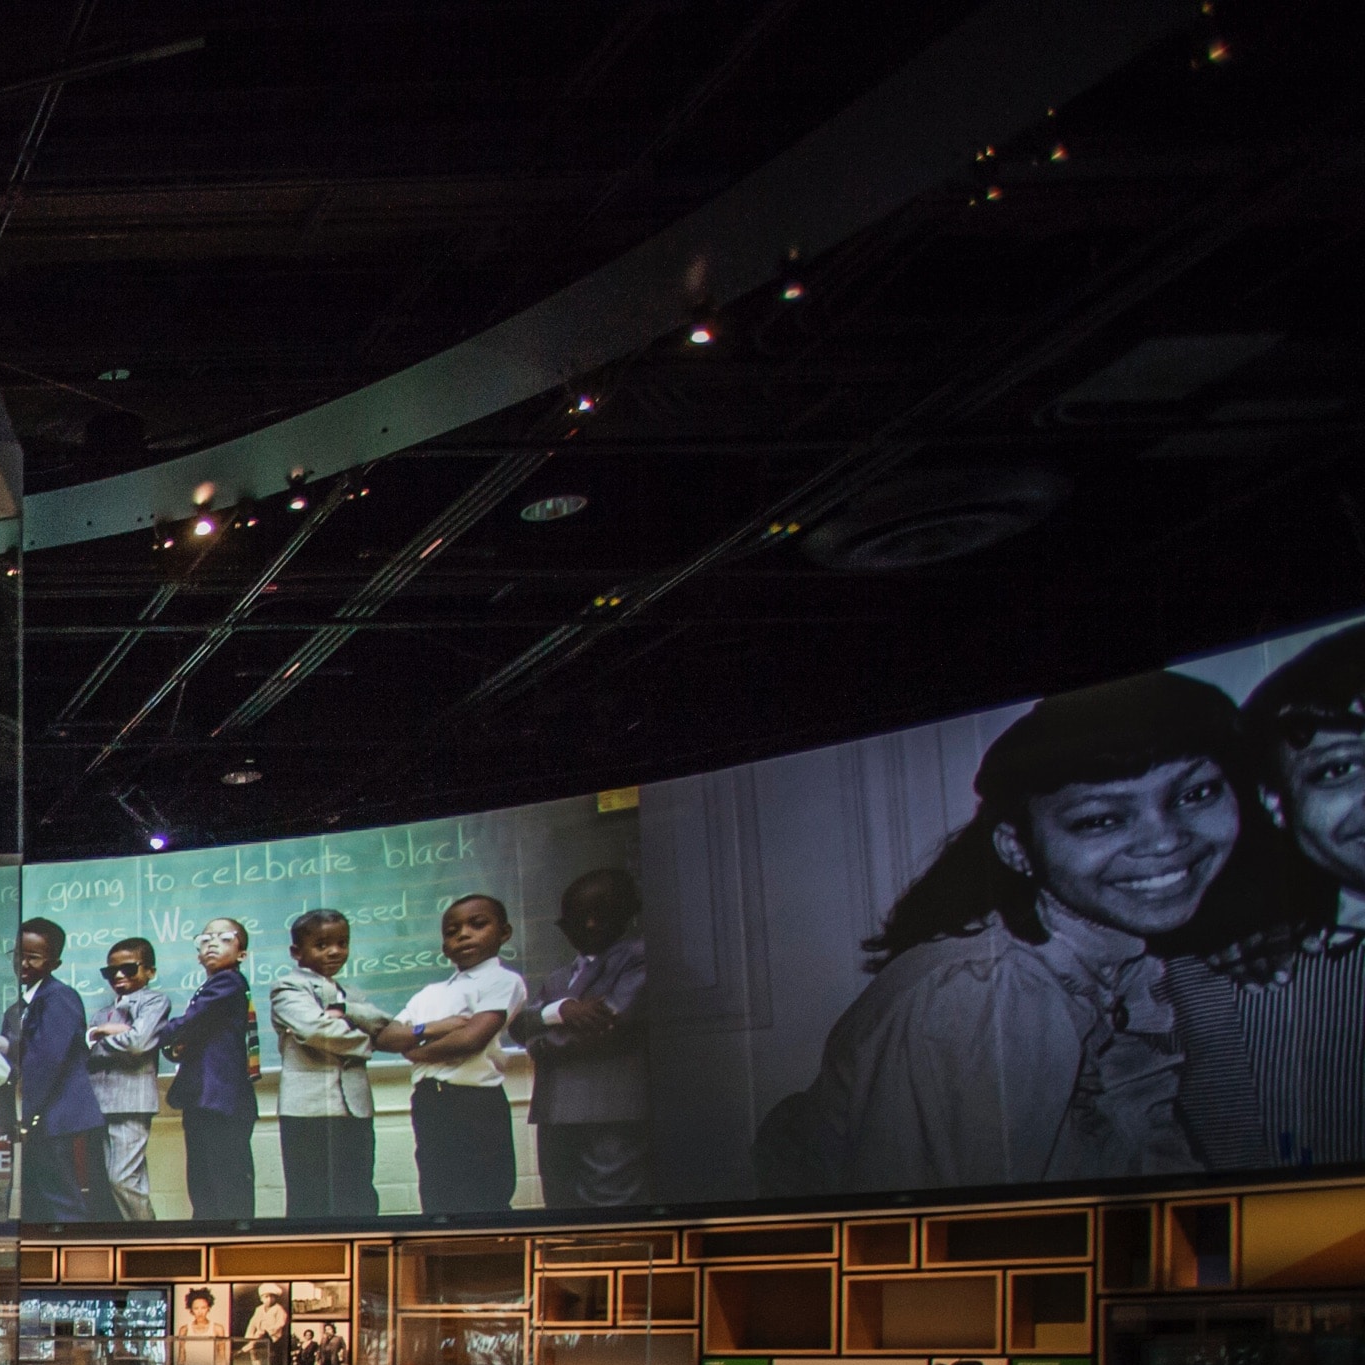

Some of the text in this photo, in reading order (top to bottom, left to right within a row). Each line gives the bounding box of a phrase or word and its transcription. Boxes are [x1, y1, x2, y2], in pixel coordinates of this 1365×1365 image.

[47, 876, 125, 912] going
[146, 862, 175, 893] to
[191, 843, 358, 888] celebrate
[382, 823, 475, 869] black
[149, 906, 196, 944] We
